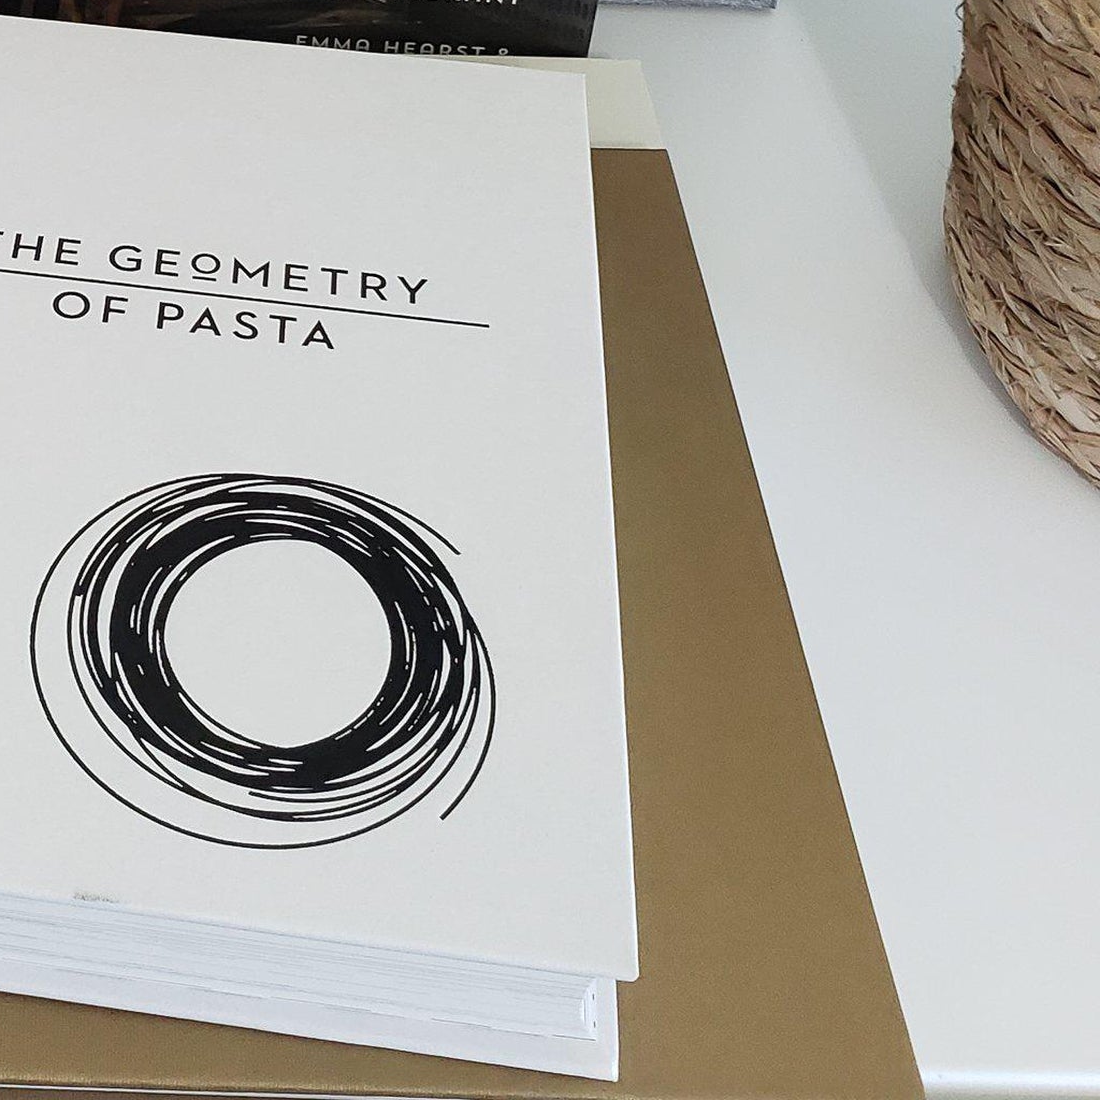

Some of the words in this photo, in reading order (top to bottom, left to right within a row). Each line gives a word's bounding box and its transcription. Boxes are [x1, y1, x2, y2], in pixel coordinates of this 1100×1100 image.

[107, 245, 428, 305] GEOMETRY
[52, 291, 129, 324] OF
[156, 301, 336, 350] PASTA
